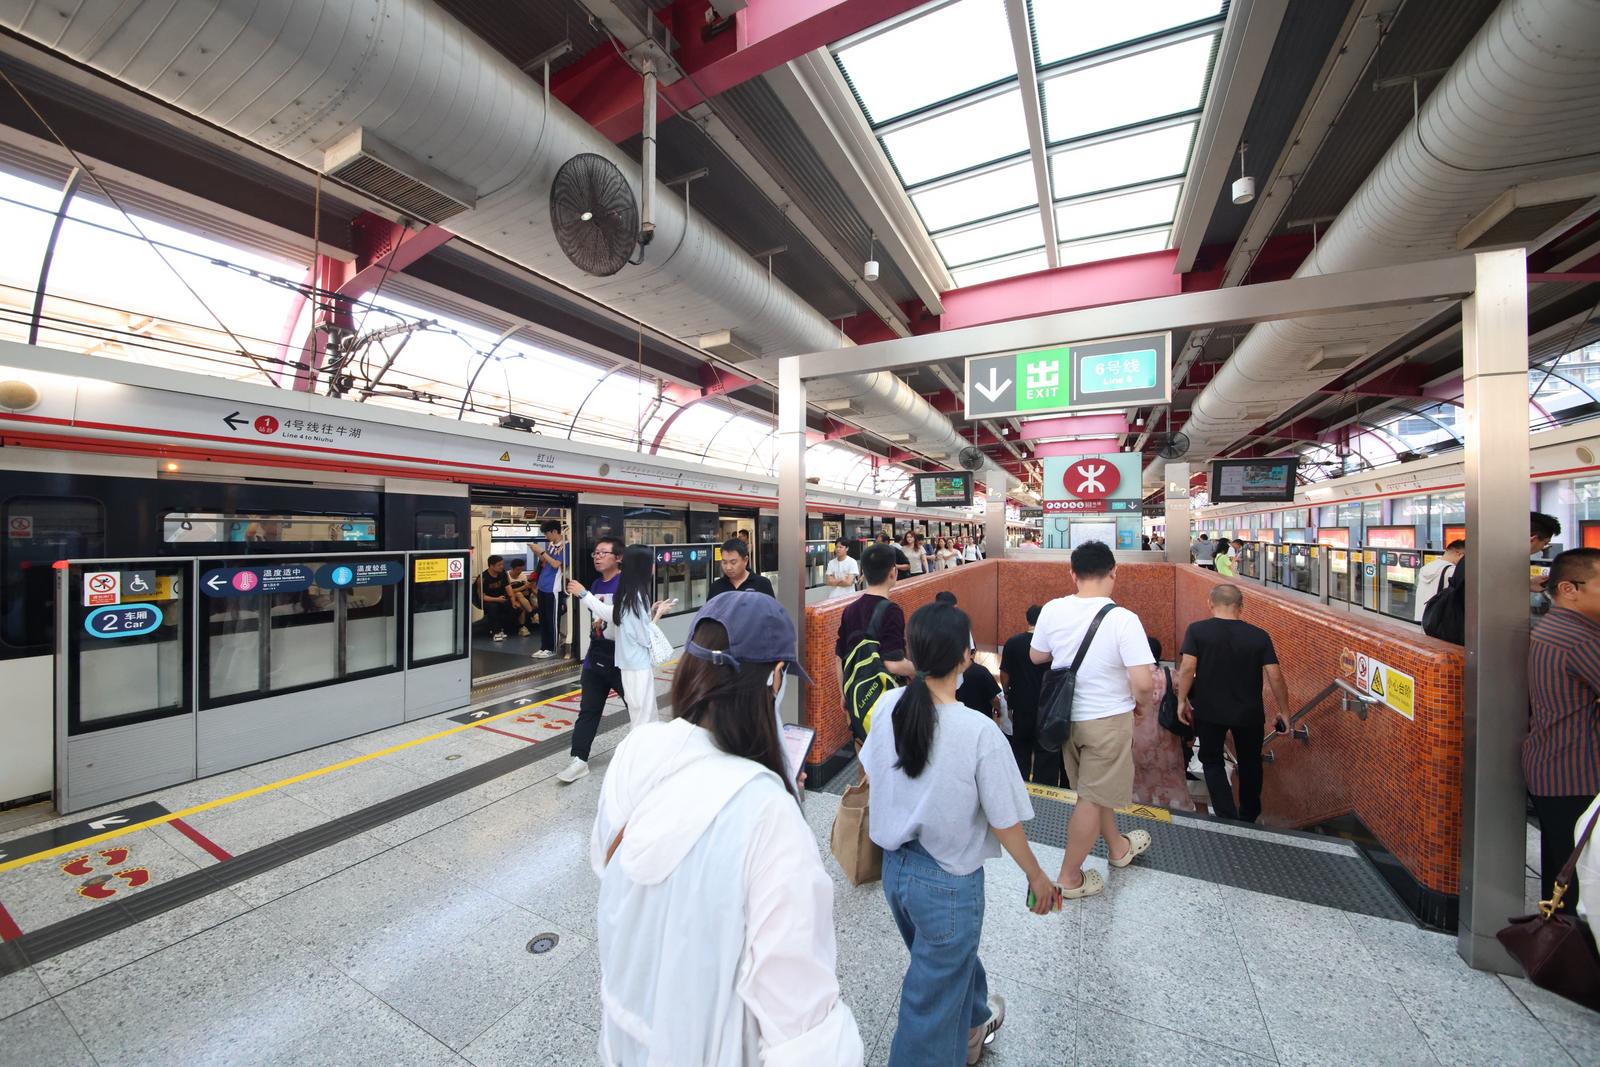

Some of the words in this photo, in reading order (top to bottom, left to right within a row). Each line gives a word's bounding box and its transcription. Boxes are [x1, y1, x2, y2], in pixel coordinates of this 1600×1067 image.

[1095, 358, 1140, 376] 6号线
[1027, 360, 1059, 388] 出
[1103, 377, 1123, 385] Line
[1026, 387, 1059, 400] EXIT
[264, 417, 271, 427] 1
[284, 419, 362, 439] 4号线往牛湖
[282, 431, 298, 439] Line
[263, 567, 301, 577] 温度适中
[356, 563, 387, 572] 温度较低
[124, 610, 148, 620] 车厢
[102, 613, 119, 631] 2
[124, 621, 144, 629] Car
